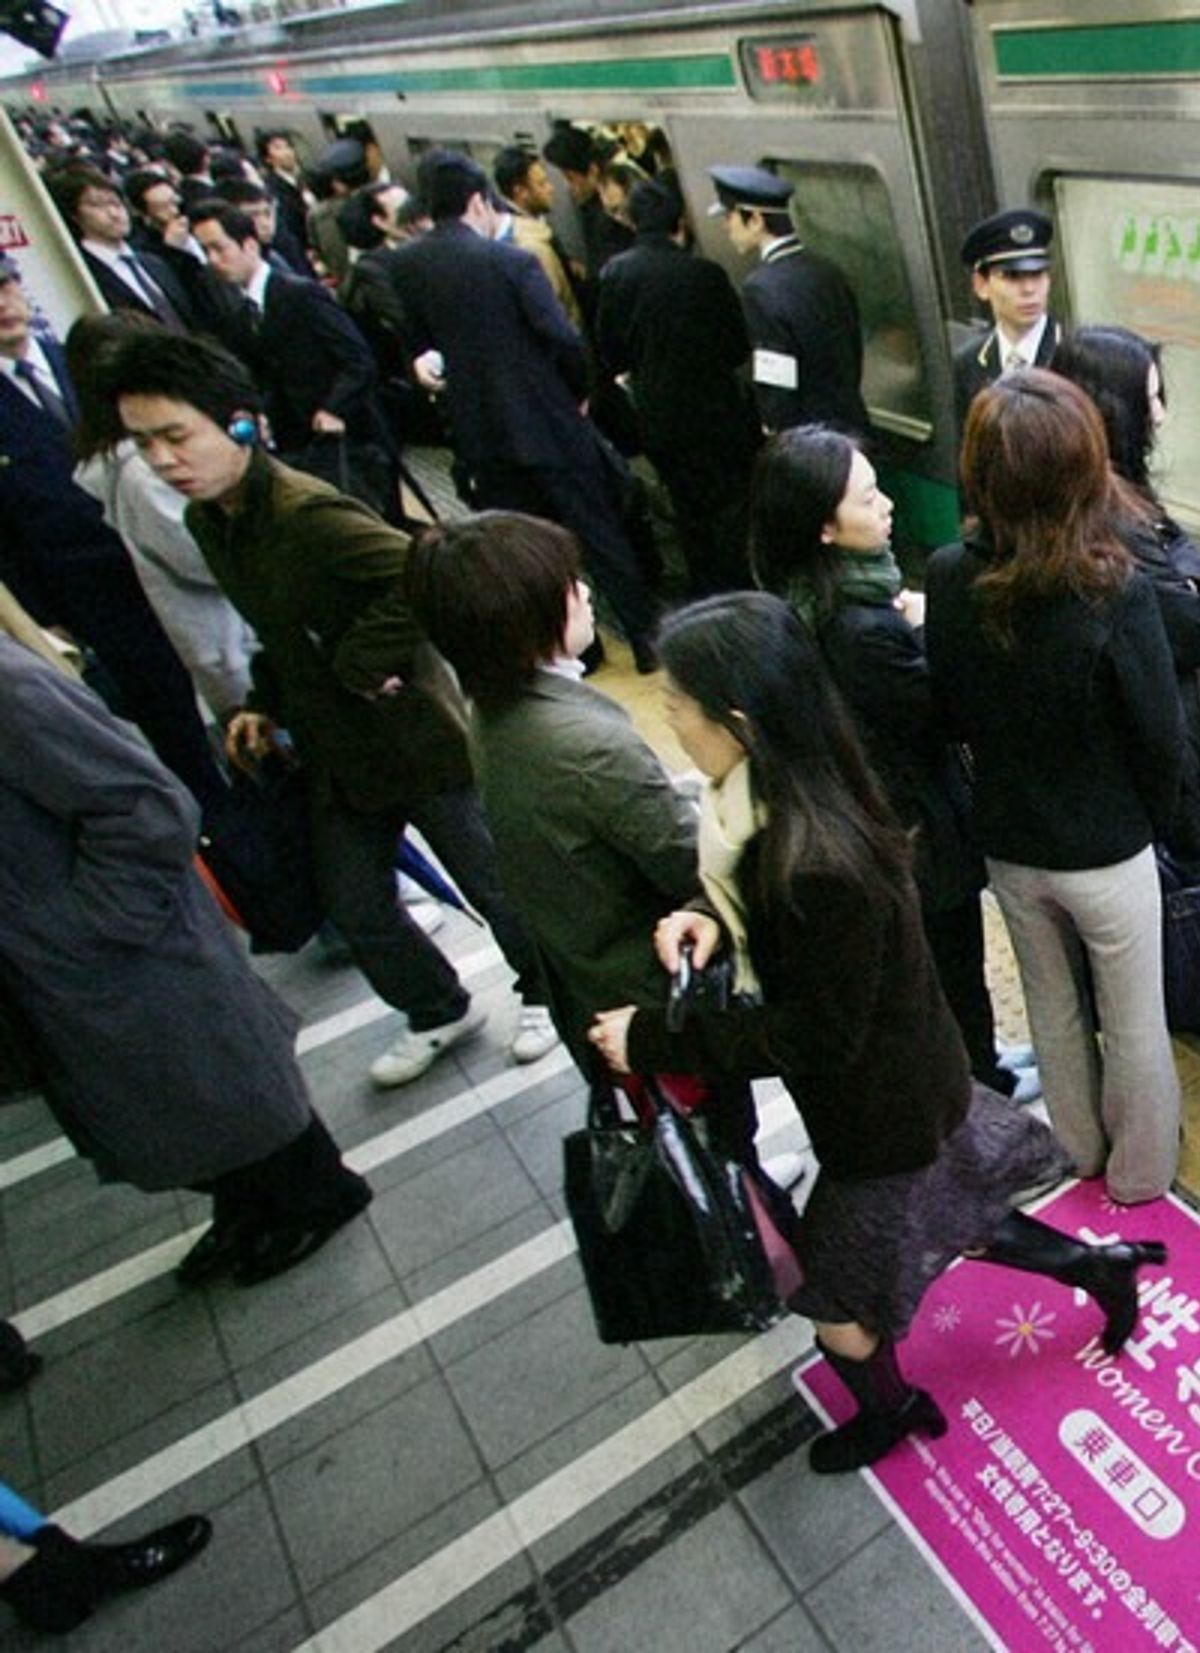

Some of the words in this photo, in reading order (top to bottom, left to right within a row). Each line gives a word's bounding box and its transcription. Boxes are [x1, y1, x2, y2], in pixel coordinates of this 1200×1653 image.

[1075, 1338, 1190, 1456] Women
[1074, 1426, 1168, 1522] 乗車口
